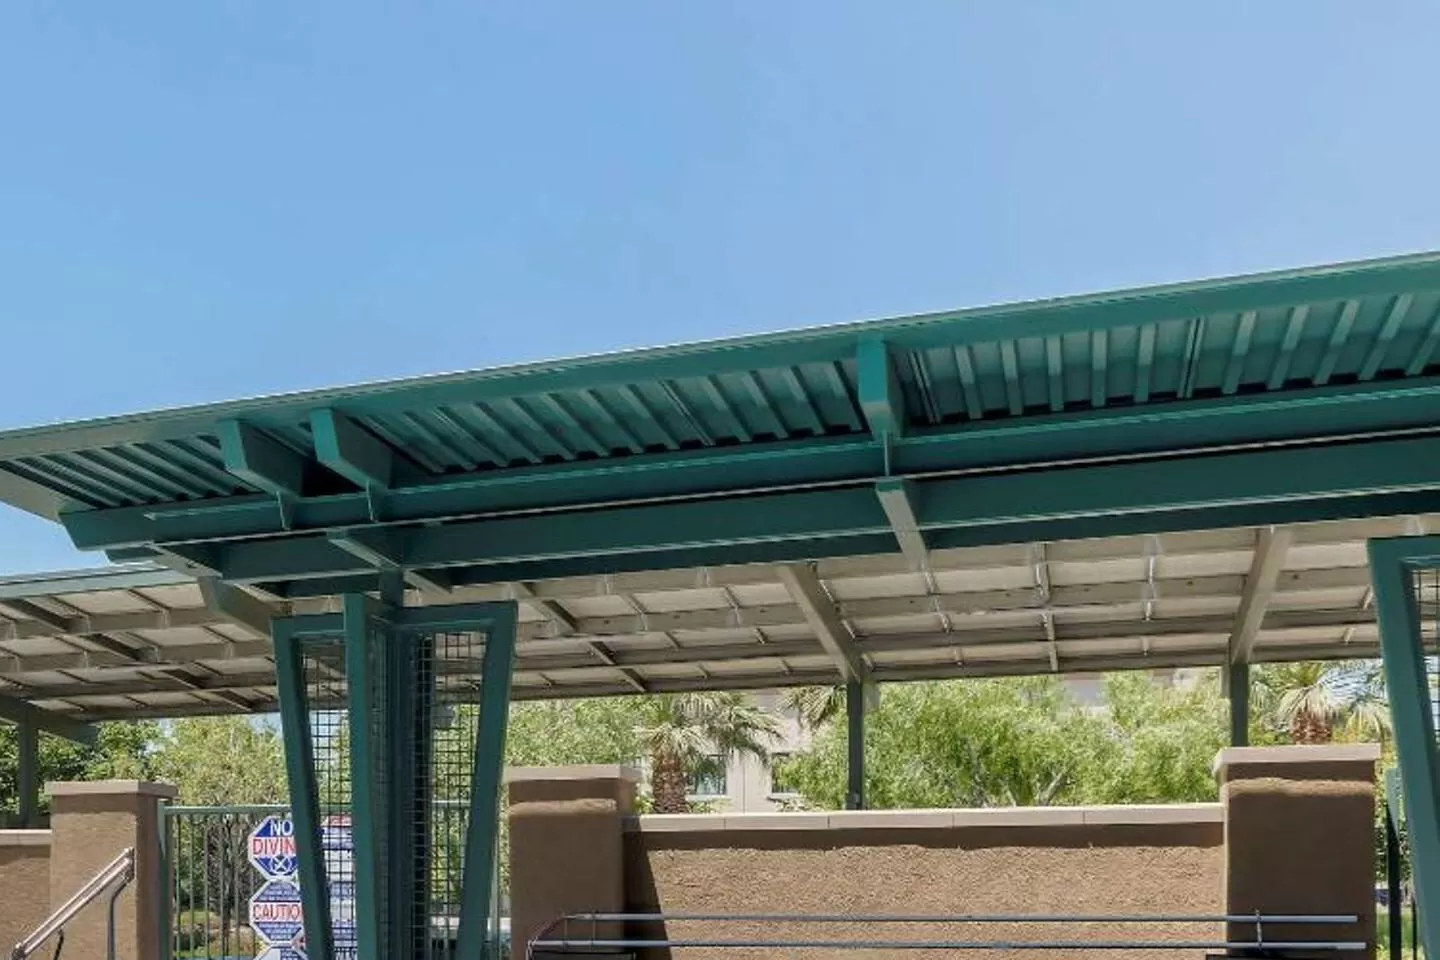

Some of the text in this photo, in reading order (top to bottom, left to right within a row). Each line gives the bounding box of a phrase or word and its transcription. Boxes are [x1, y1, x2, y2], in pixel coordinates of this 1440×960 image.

[270, 820, 293, 836] NO
[253, 838, 297, 855] DIVIN
[253, 904, 303, 920] CAUTIO
